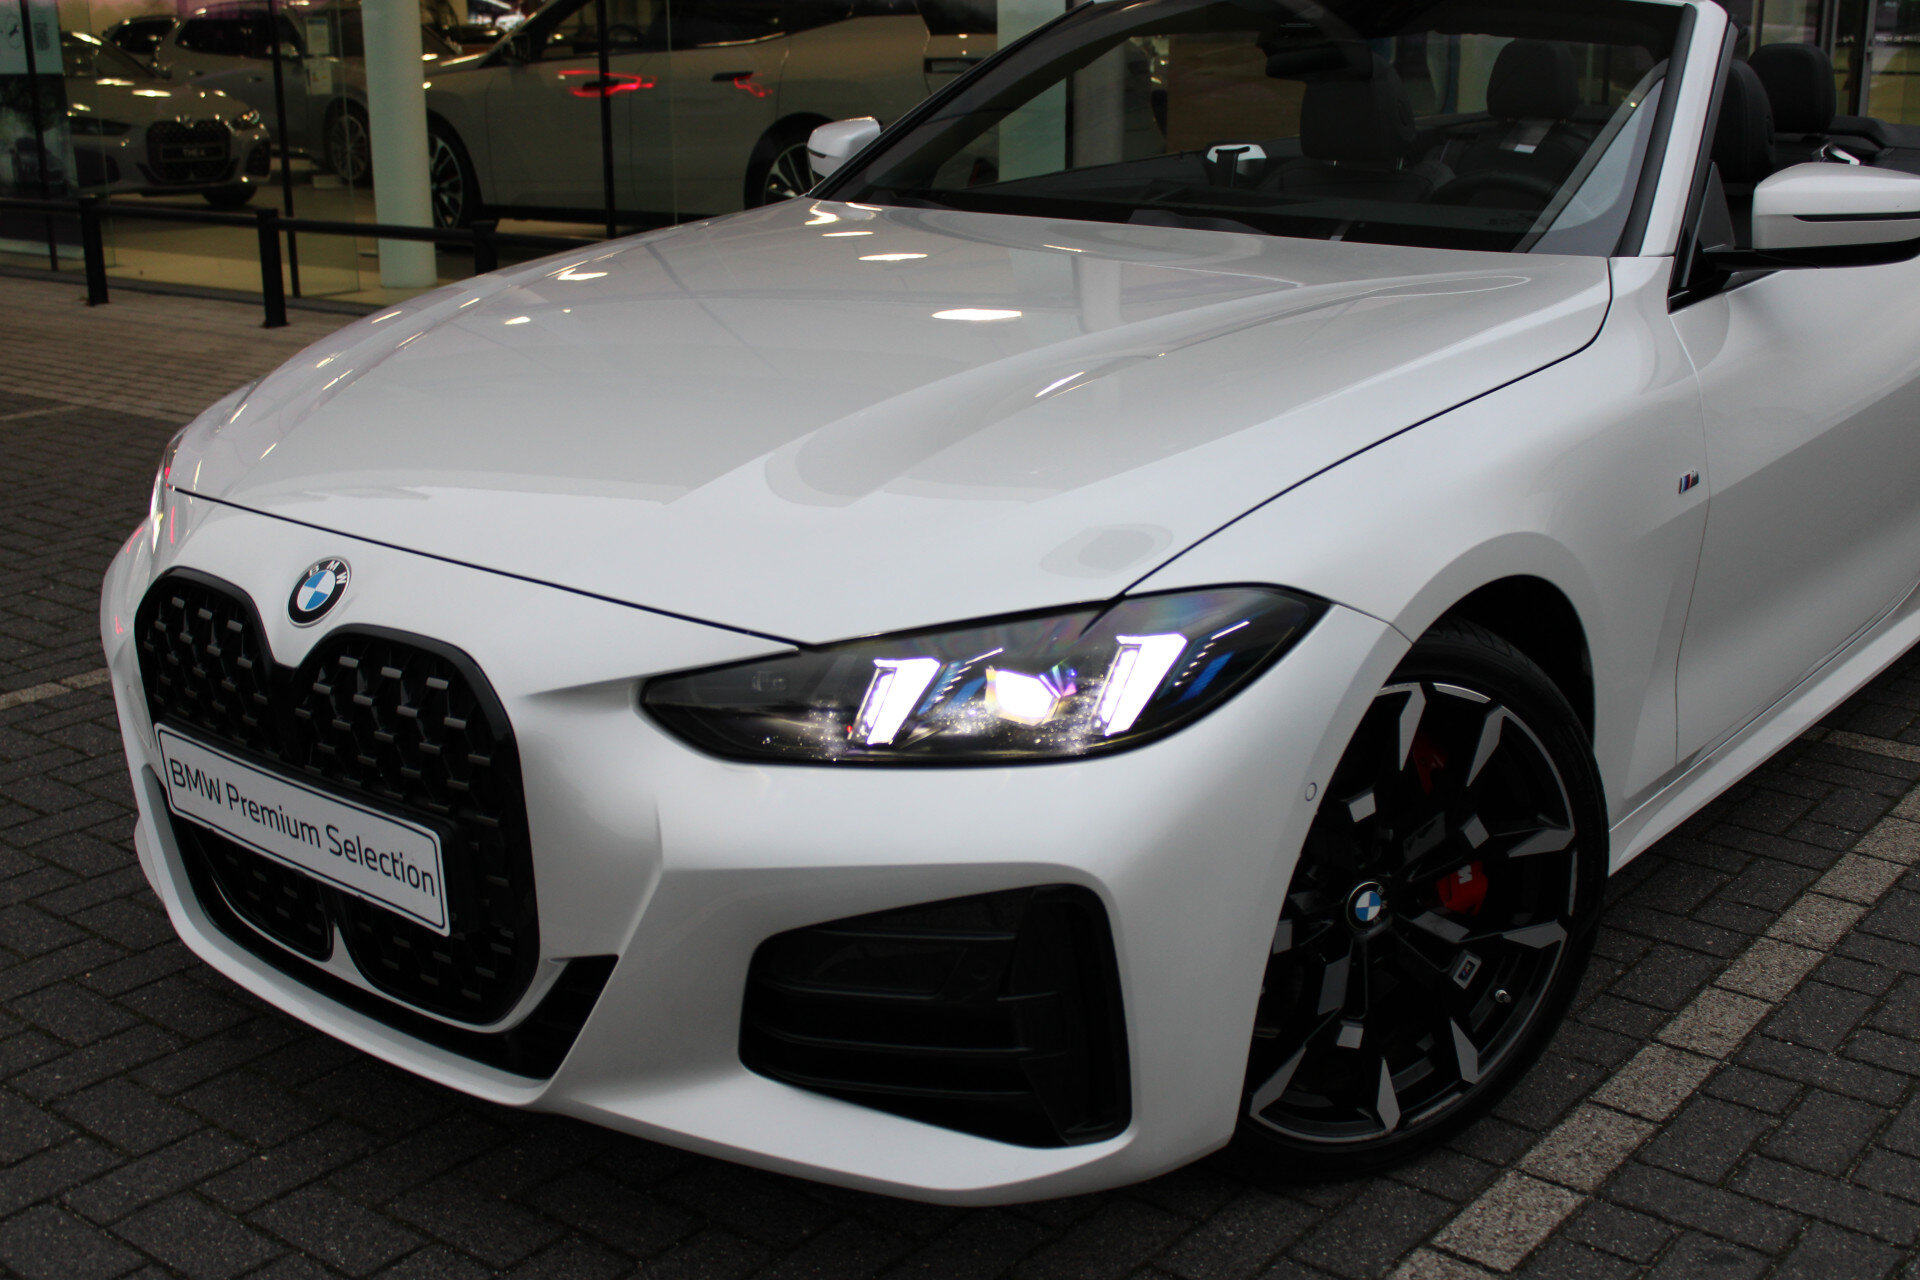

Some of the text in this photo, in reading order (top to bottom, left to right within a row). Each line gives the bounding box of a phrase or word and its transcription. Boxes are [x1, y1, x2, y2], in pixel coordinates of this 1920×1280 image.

[308, 560, 347, 585] BMW
[169, 758, 435, 897] BMW Premium Selection
